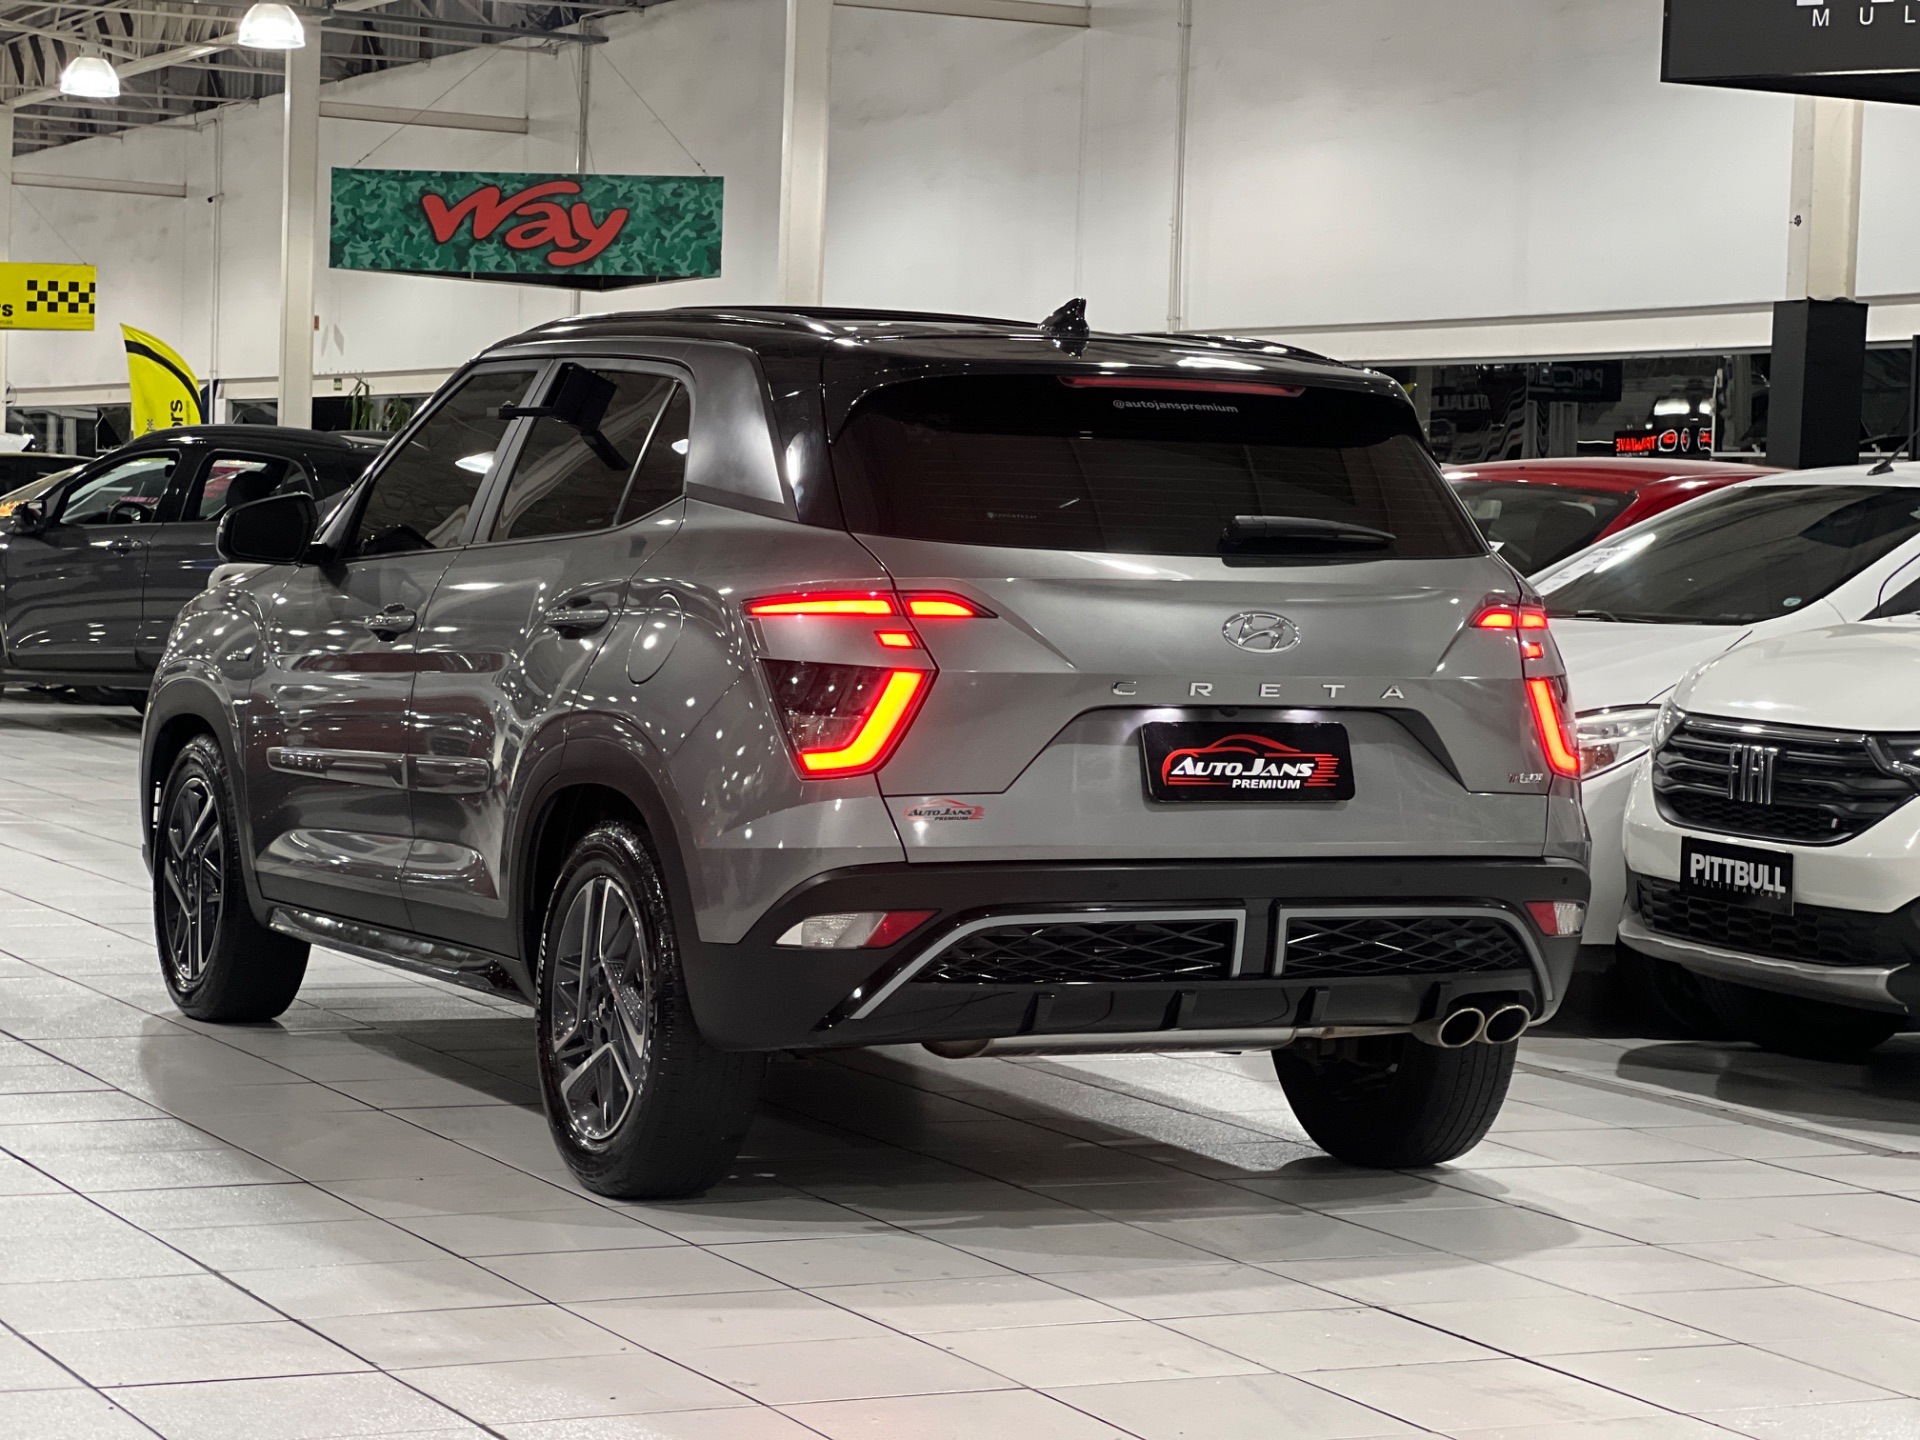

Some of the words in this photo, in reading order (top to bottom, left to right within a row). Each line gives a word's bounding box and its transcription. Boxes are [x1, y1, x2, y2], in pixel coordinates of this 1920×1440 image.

[1811, 5, 1917, 27] MUL
[422, 180, 630, 267] Way
[1112, 399, 1239, 413] @autojanspremium
[1110, 680, 1405, 700] CRETA
[280, 754, 323, 769] CRETA
[1231, 778, 1301, 790] PREMIUM
[1727, 742, 1779, 805] FIAT
[1689, 852, 1787, 894] PITTBULL
